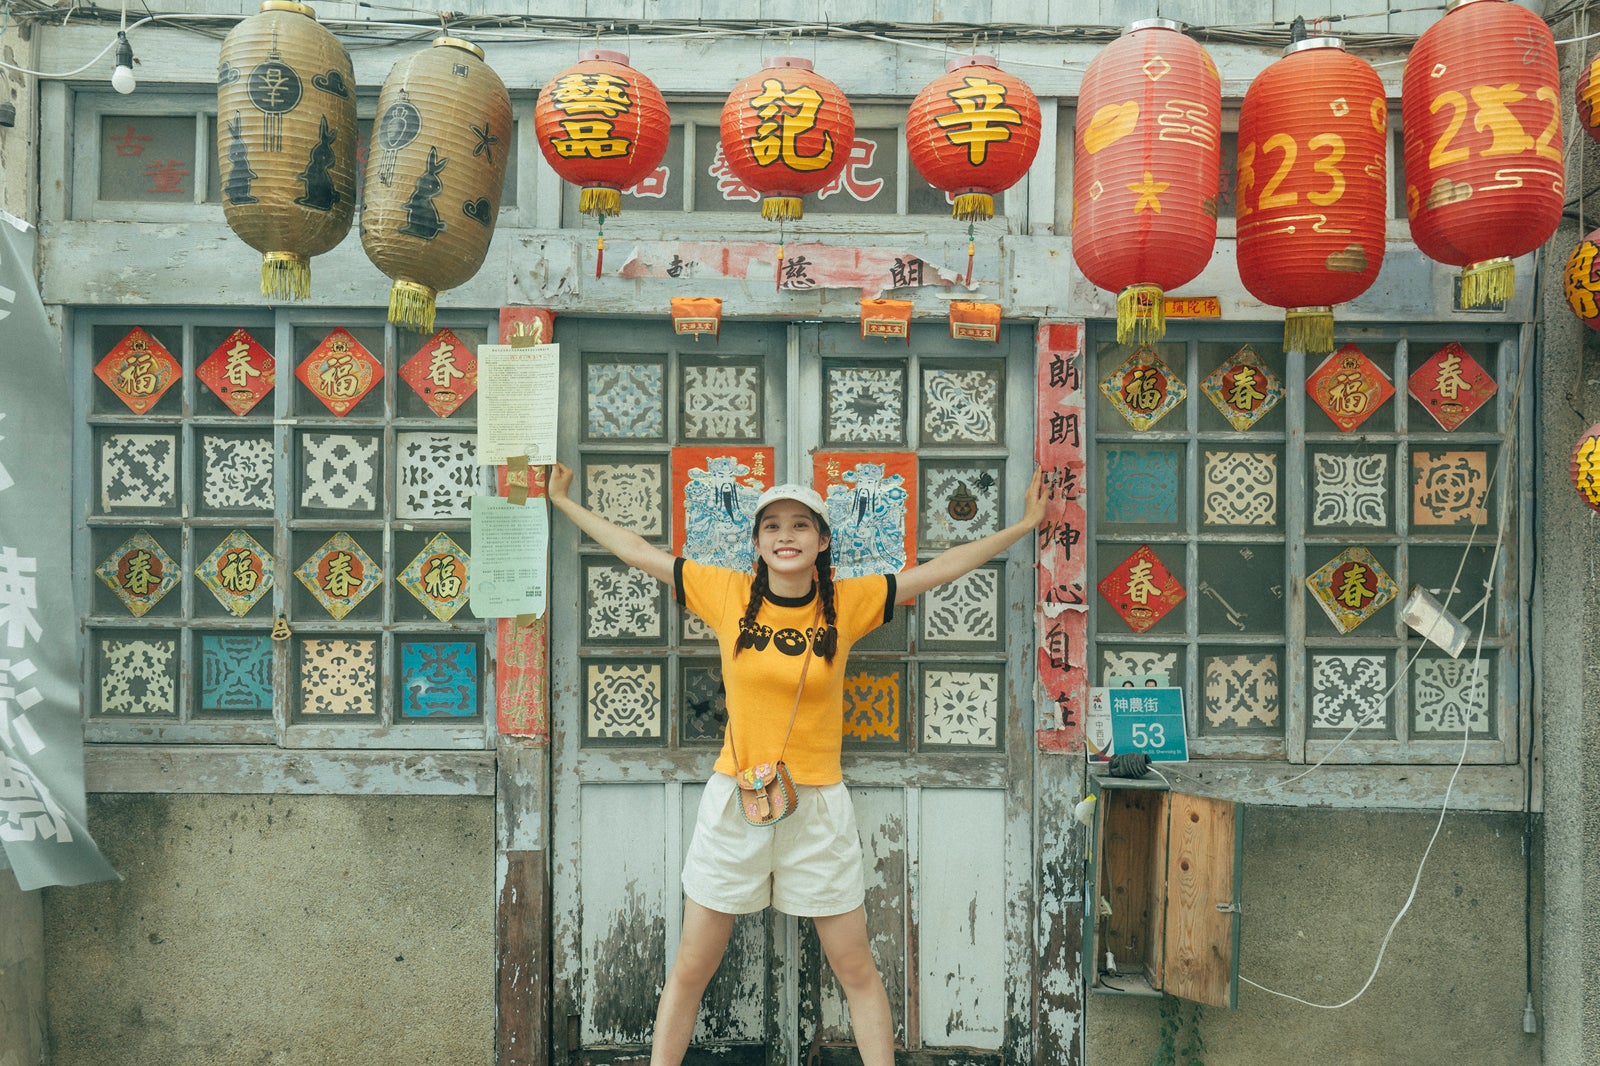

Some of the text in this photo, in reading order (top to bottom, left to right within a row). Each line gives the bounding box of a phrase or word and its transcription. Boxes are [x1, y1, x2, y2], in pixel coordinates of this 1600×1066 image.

[550, 73, 633, 159] 藝品
[749, 77, 834, 172] 記
[935, 76, 1023, 167] 辛
[109, 125, 190, 193] 古董
[1164, 299, 1216, 315] 彌陀佛
[120, 353, 157, 396] 福
[221, 340, 263, 388] 春
[320, 353, 358, 396] 福
[424, 342, 465, 388] 春
[1430, 352, 1472, 400] 春
[1126, 368, 1160, 411] 福
[1227, 367, 1266, 411] 春
[1330, 372, 1369, 415] 福
[124, 550, 161, 597] 春
[221, 550, 259, 593] 福
[323, 553, 362, 598] 春
[424, 555, 463, 598] 福
[1124, 558, 1163, 604] 春
[1336, 563, 1375, 608] 春
[1113, 697, 1158, 713] 神農街
[1132, 722, 1166, 748] 53
